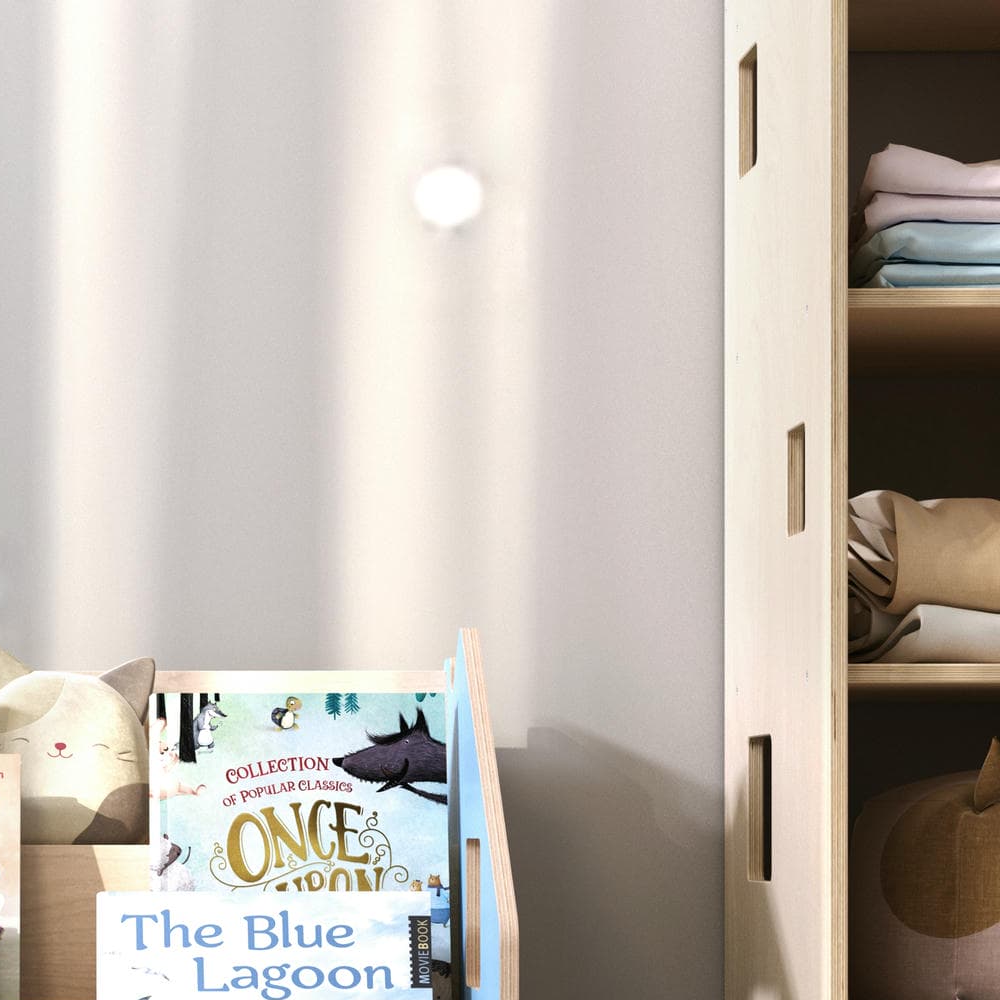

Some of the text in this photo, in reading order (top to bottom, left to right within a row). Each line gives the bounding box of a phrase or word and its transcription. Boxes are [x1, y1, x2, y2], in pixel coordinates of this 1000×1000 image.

[225, 757, 329, 784] COLLECTION
[222, 780, 353, 807] OF POPULAR CLASSICS
[225, 799, 372, 883] ONCE
[121, 909, 355, 951] The Blue
[416, 919, 431, 984] MOVIEBOOK
[192, 956, 395, 1000] Lagoon
